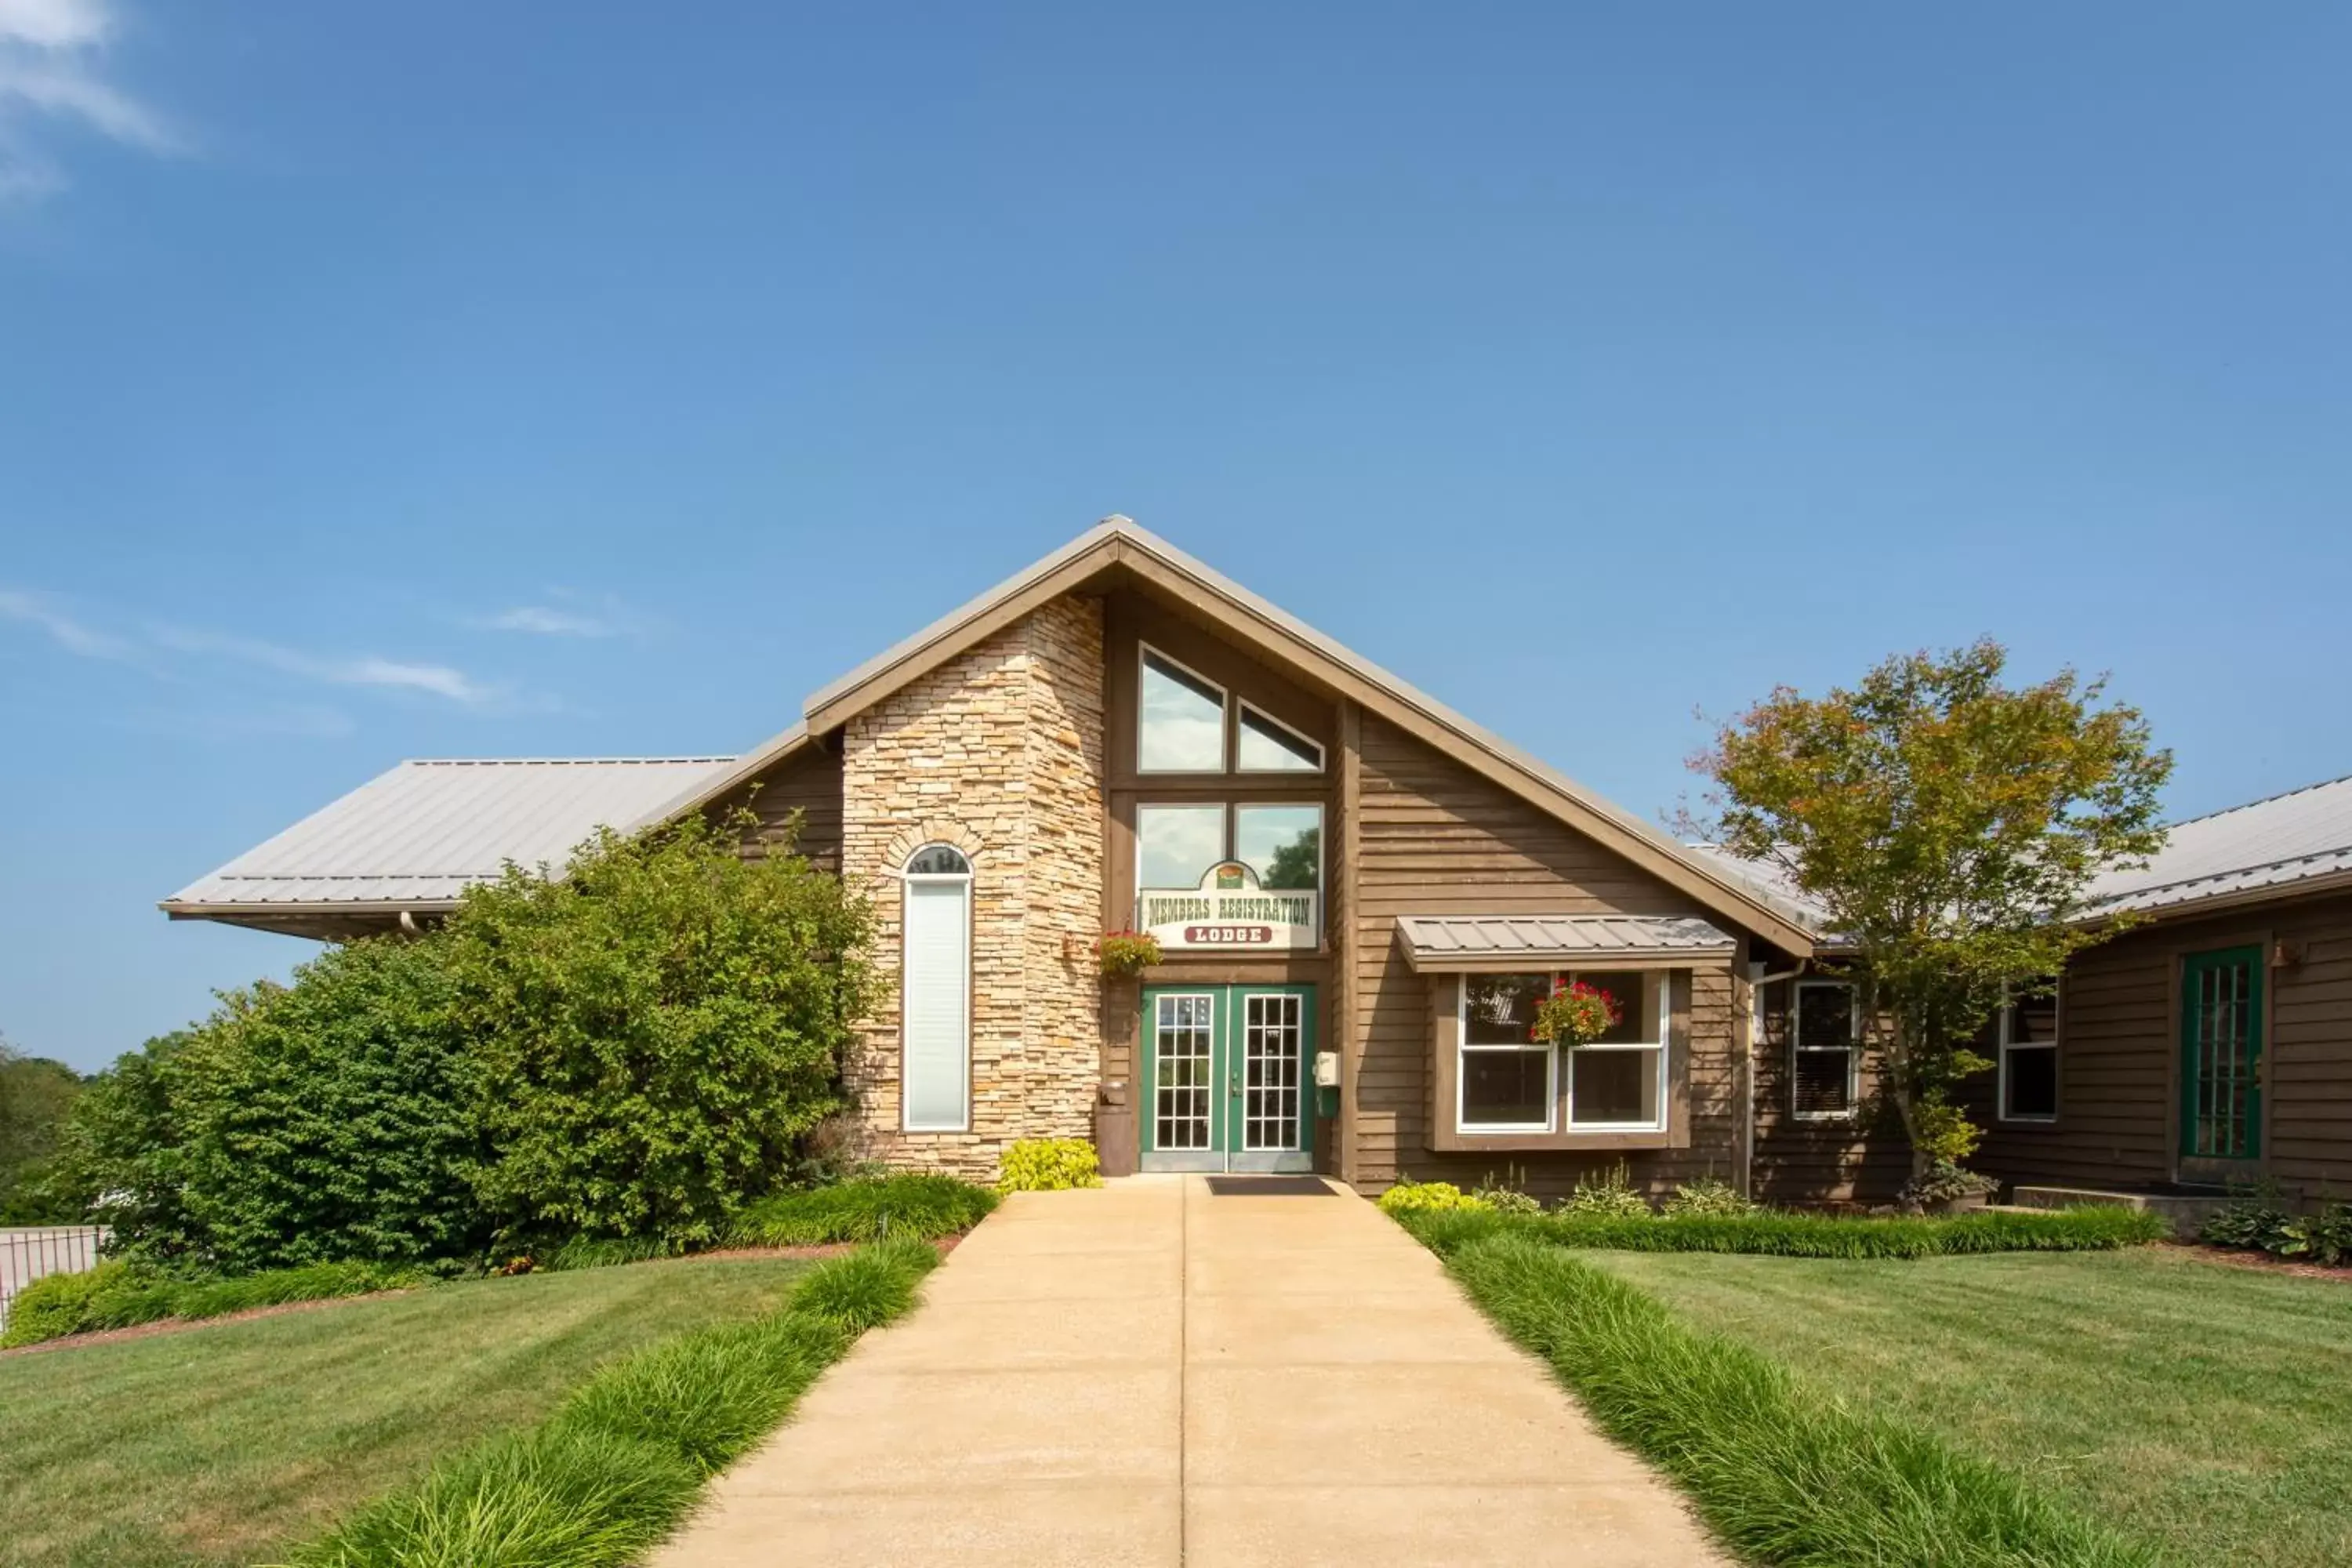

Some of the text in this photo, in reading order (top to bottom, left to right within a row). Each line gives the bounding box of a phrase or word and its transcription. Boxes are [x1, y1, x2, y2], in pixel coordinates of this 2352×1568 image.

[1149, 898, 1310, 927] MEMBERS REGISTRATION
[1195, 928, 1261, 941] LODGE
